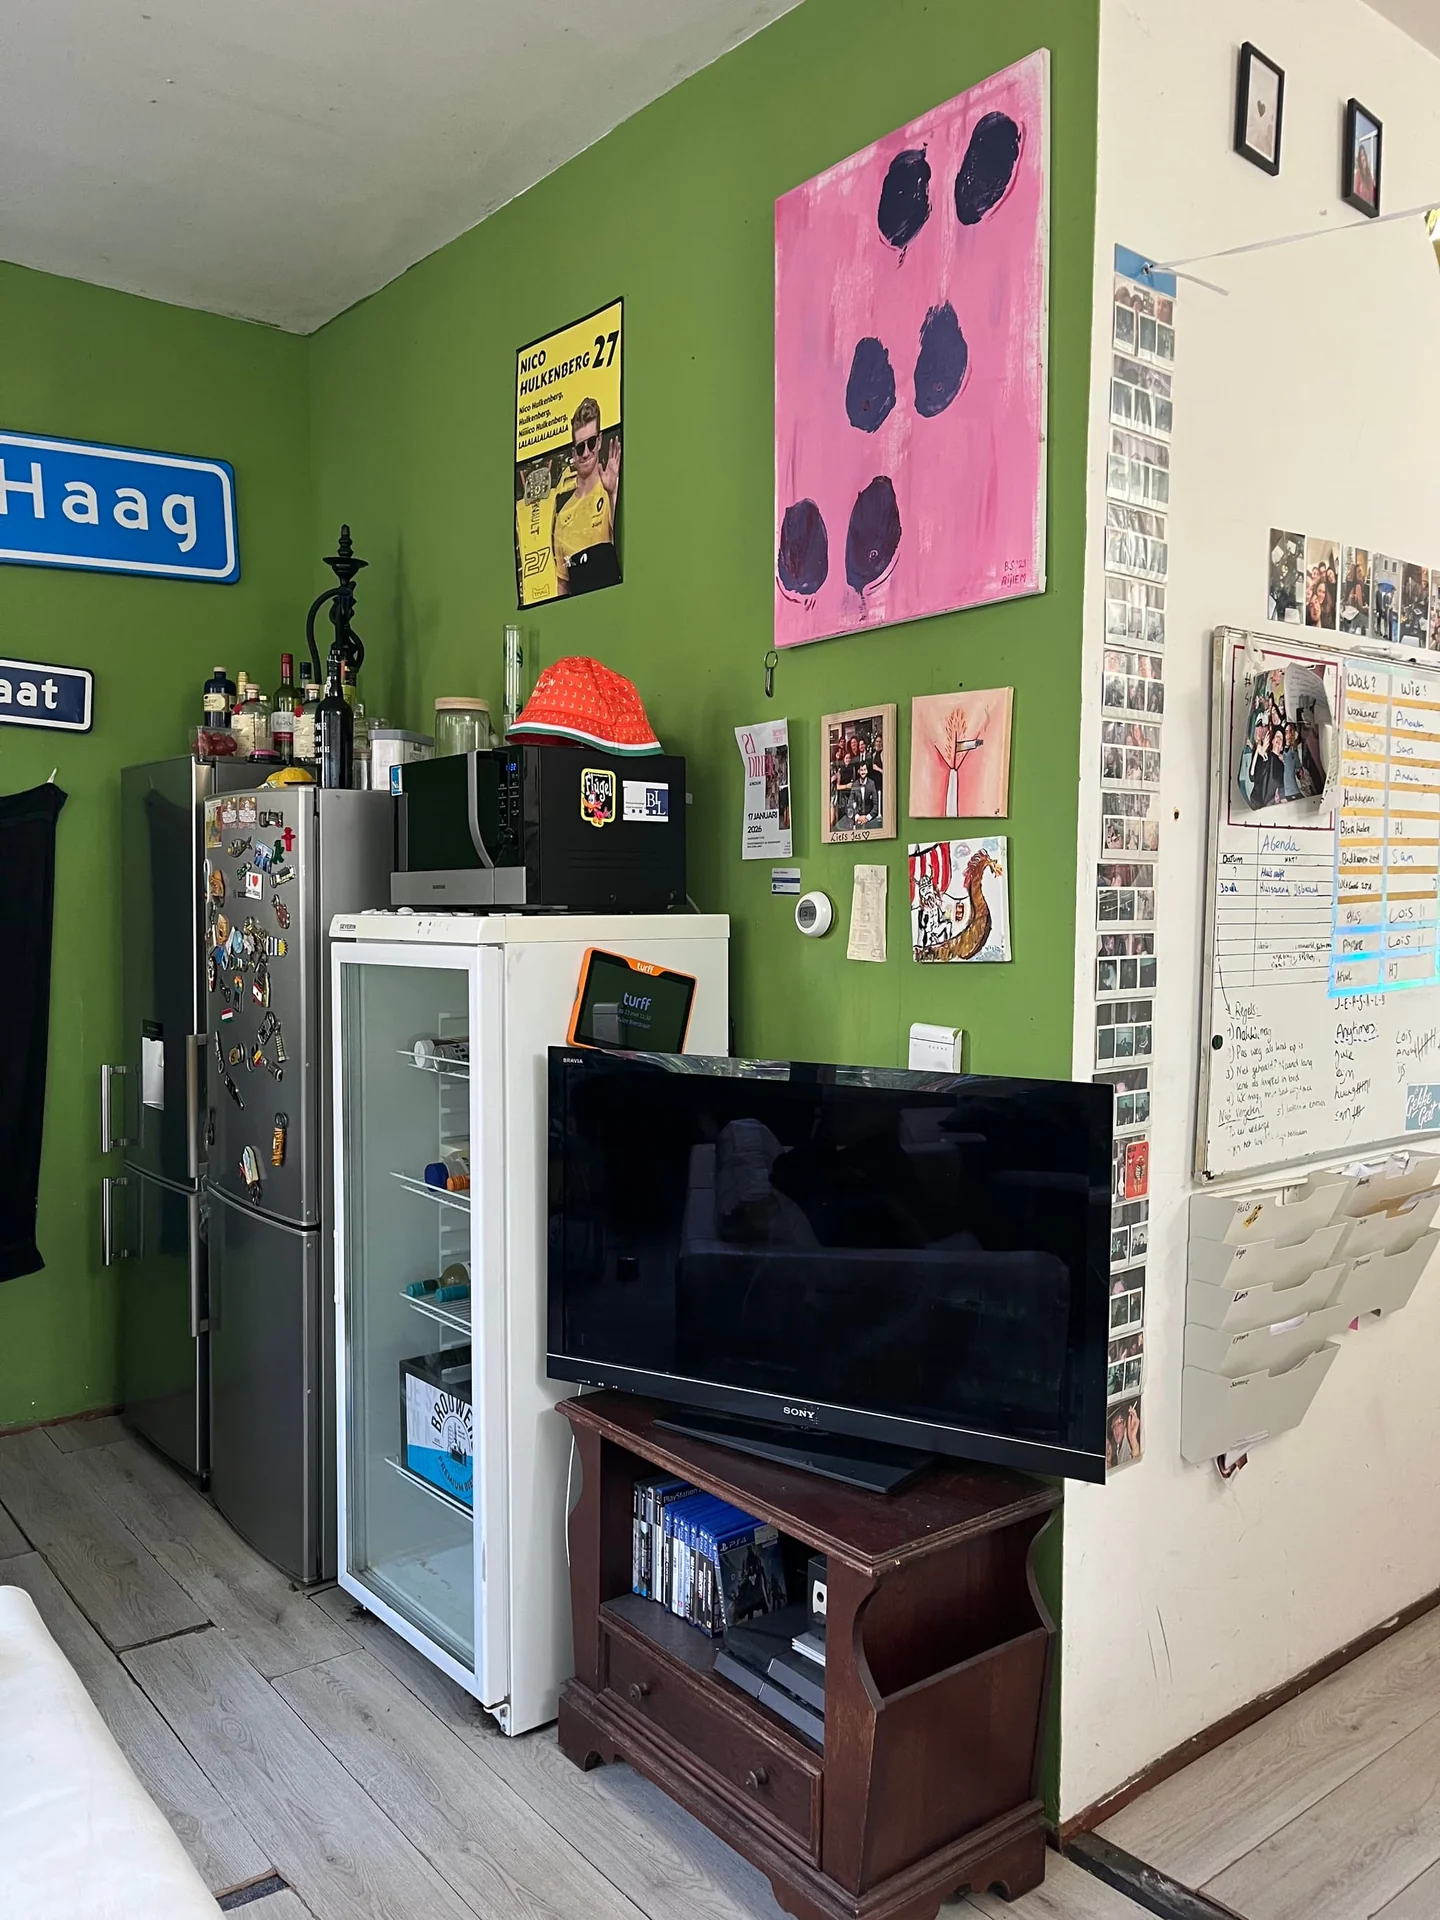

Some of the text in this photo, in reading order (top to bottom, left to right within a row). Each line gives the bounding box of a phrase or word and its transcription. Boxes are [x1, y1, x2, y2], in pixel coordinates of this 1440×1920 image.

[520, 350, 546, 374] NICO
[520, 330, 619, 396] HULKENBERG 27
[519, 405, 531, 414] Nico
[0, 458, 198, 553] Haag
[524, 546, 550, 578] 27
[754, 810, 778, 820] JANUARI
[748, 826, 762, 834] 2026
[636, 962, 654, 974] turff
[623, 992, 652, 1010] turff
[783, 1406, 816, 1418] SONY
[664, 1488, 698, 1503] PlayStation
[729, 1537, 747, 1548] PS4
